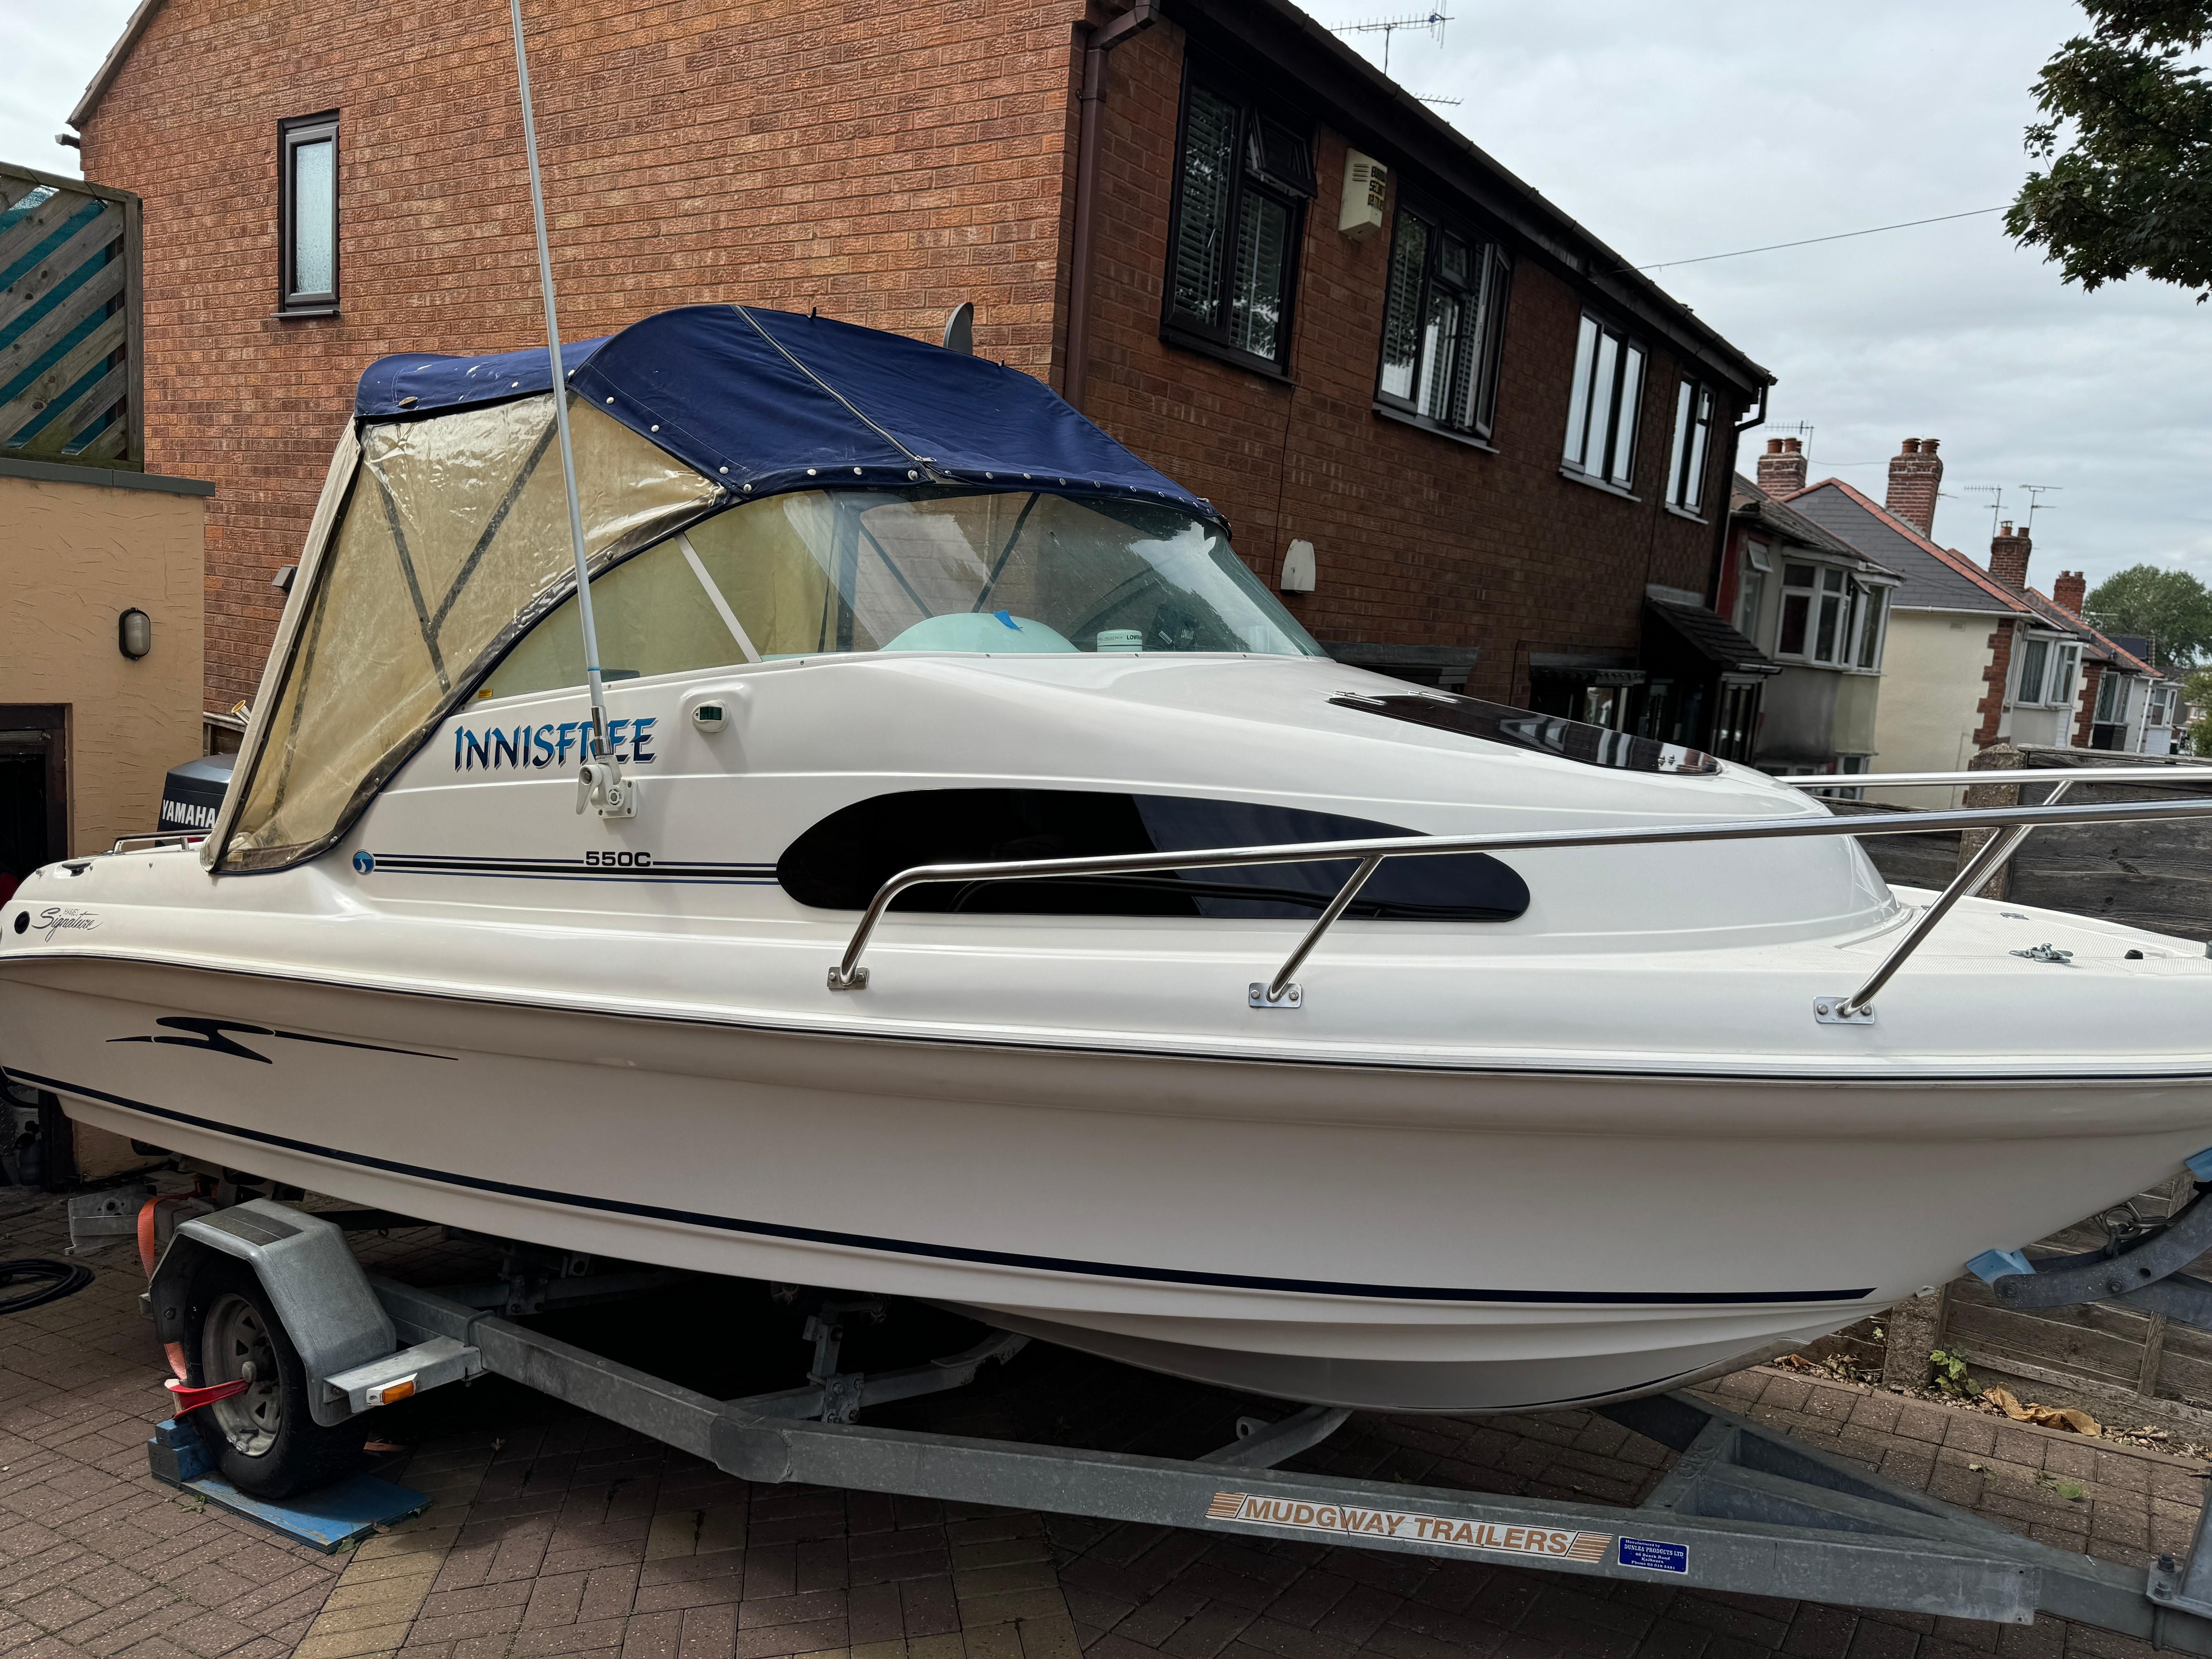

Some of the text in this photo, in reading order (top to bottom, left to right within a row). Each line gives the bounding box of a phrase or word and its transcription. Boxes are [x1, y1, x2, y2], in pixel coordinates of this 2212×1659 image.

[454, 717, 657, 772] INNISFREE
[162, 799, 215, 828] YAMAHA
[586, 851, 651, 867] 550C
[31, 907, 104, 943] Signature
[1245, 1498, 1568, 1553] MUDGWAY TRAILERS
[1646, 1547, 1673, 1556] PRODUCTS
